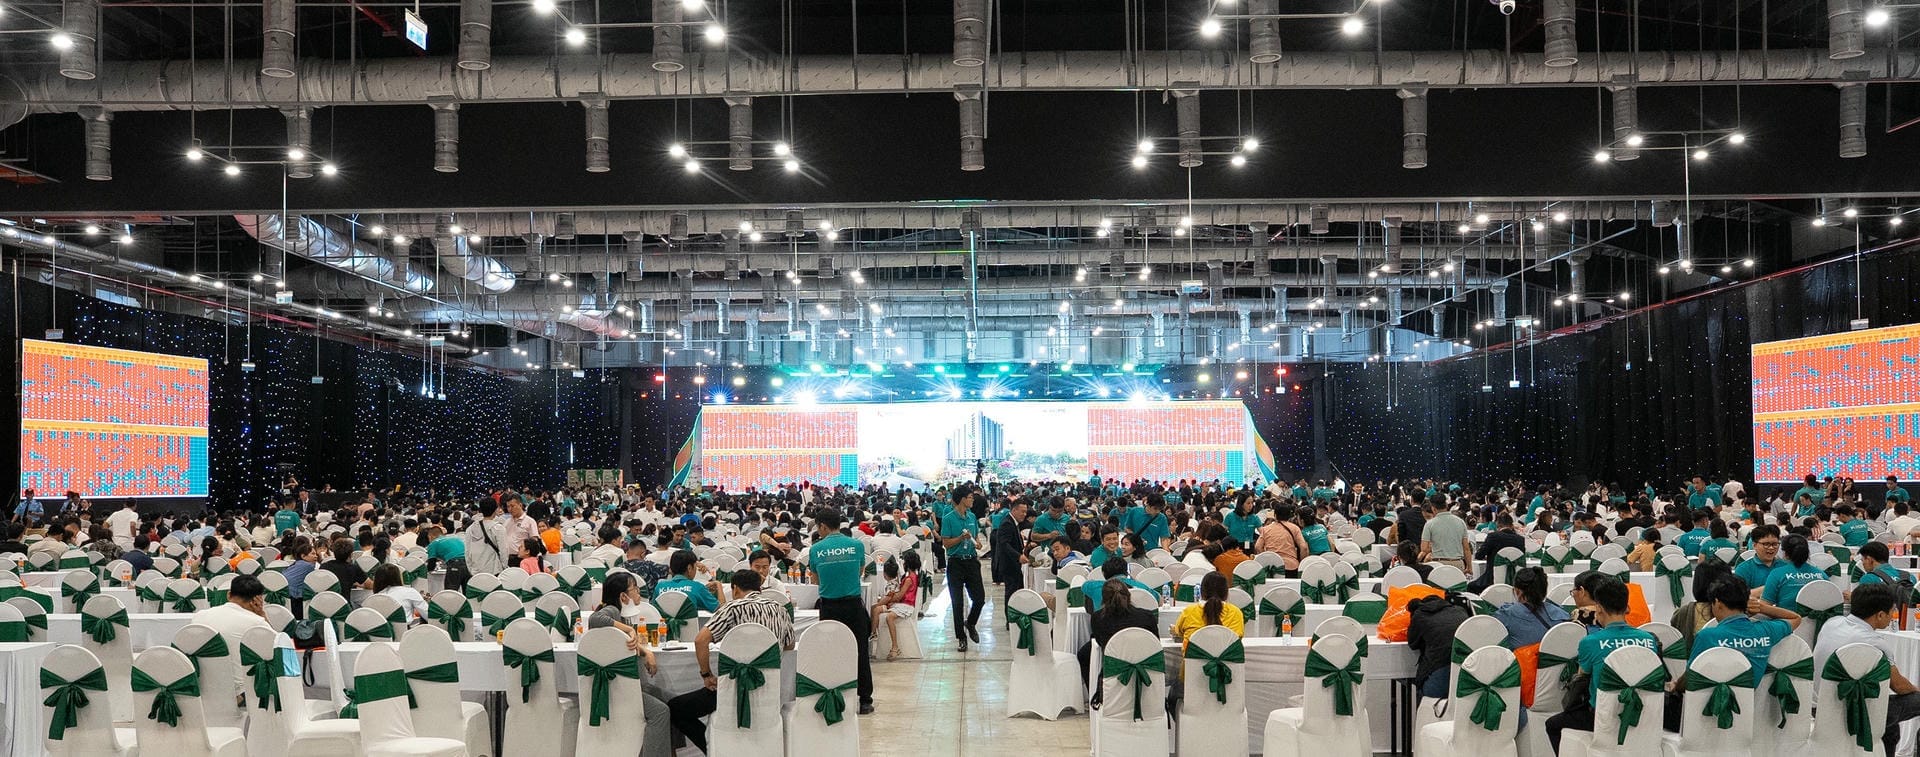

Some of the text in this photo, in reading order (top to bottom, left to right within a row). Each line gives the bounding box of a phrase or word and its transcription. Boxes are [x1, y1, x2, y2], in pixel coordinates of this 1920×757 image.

[816, 547, 856, 558] K-HOME
[1599, 638, 1654, 650] K-HOME
[1718, 636, 1771, 648] K-HOME
